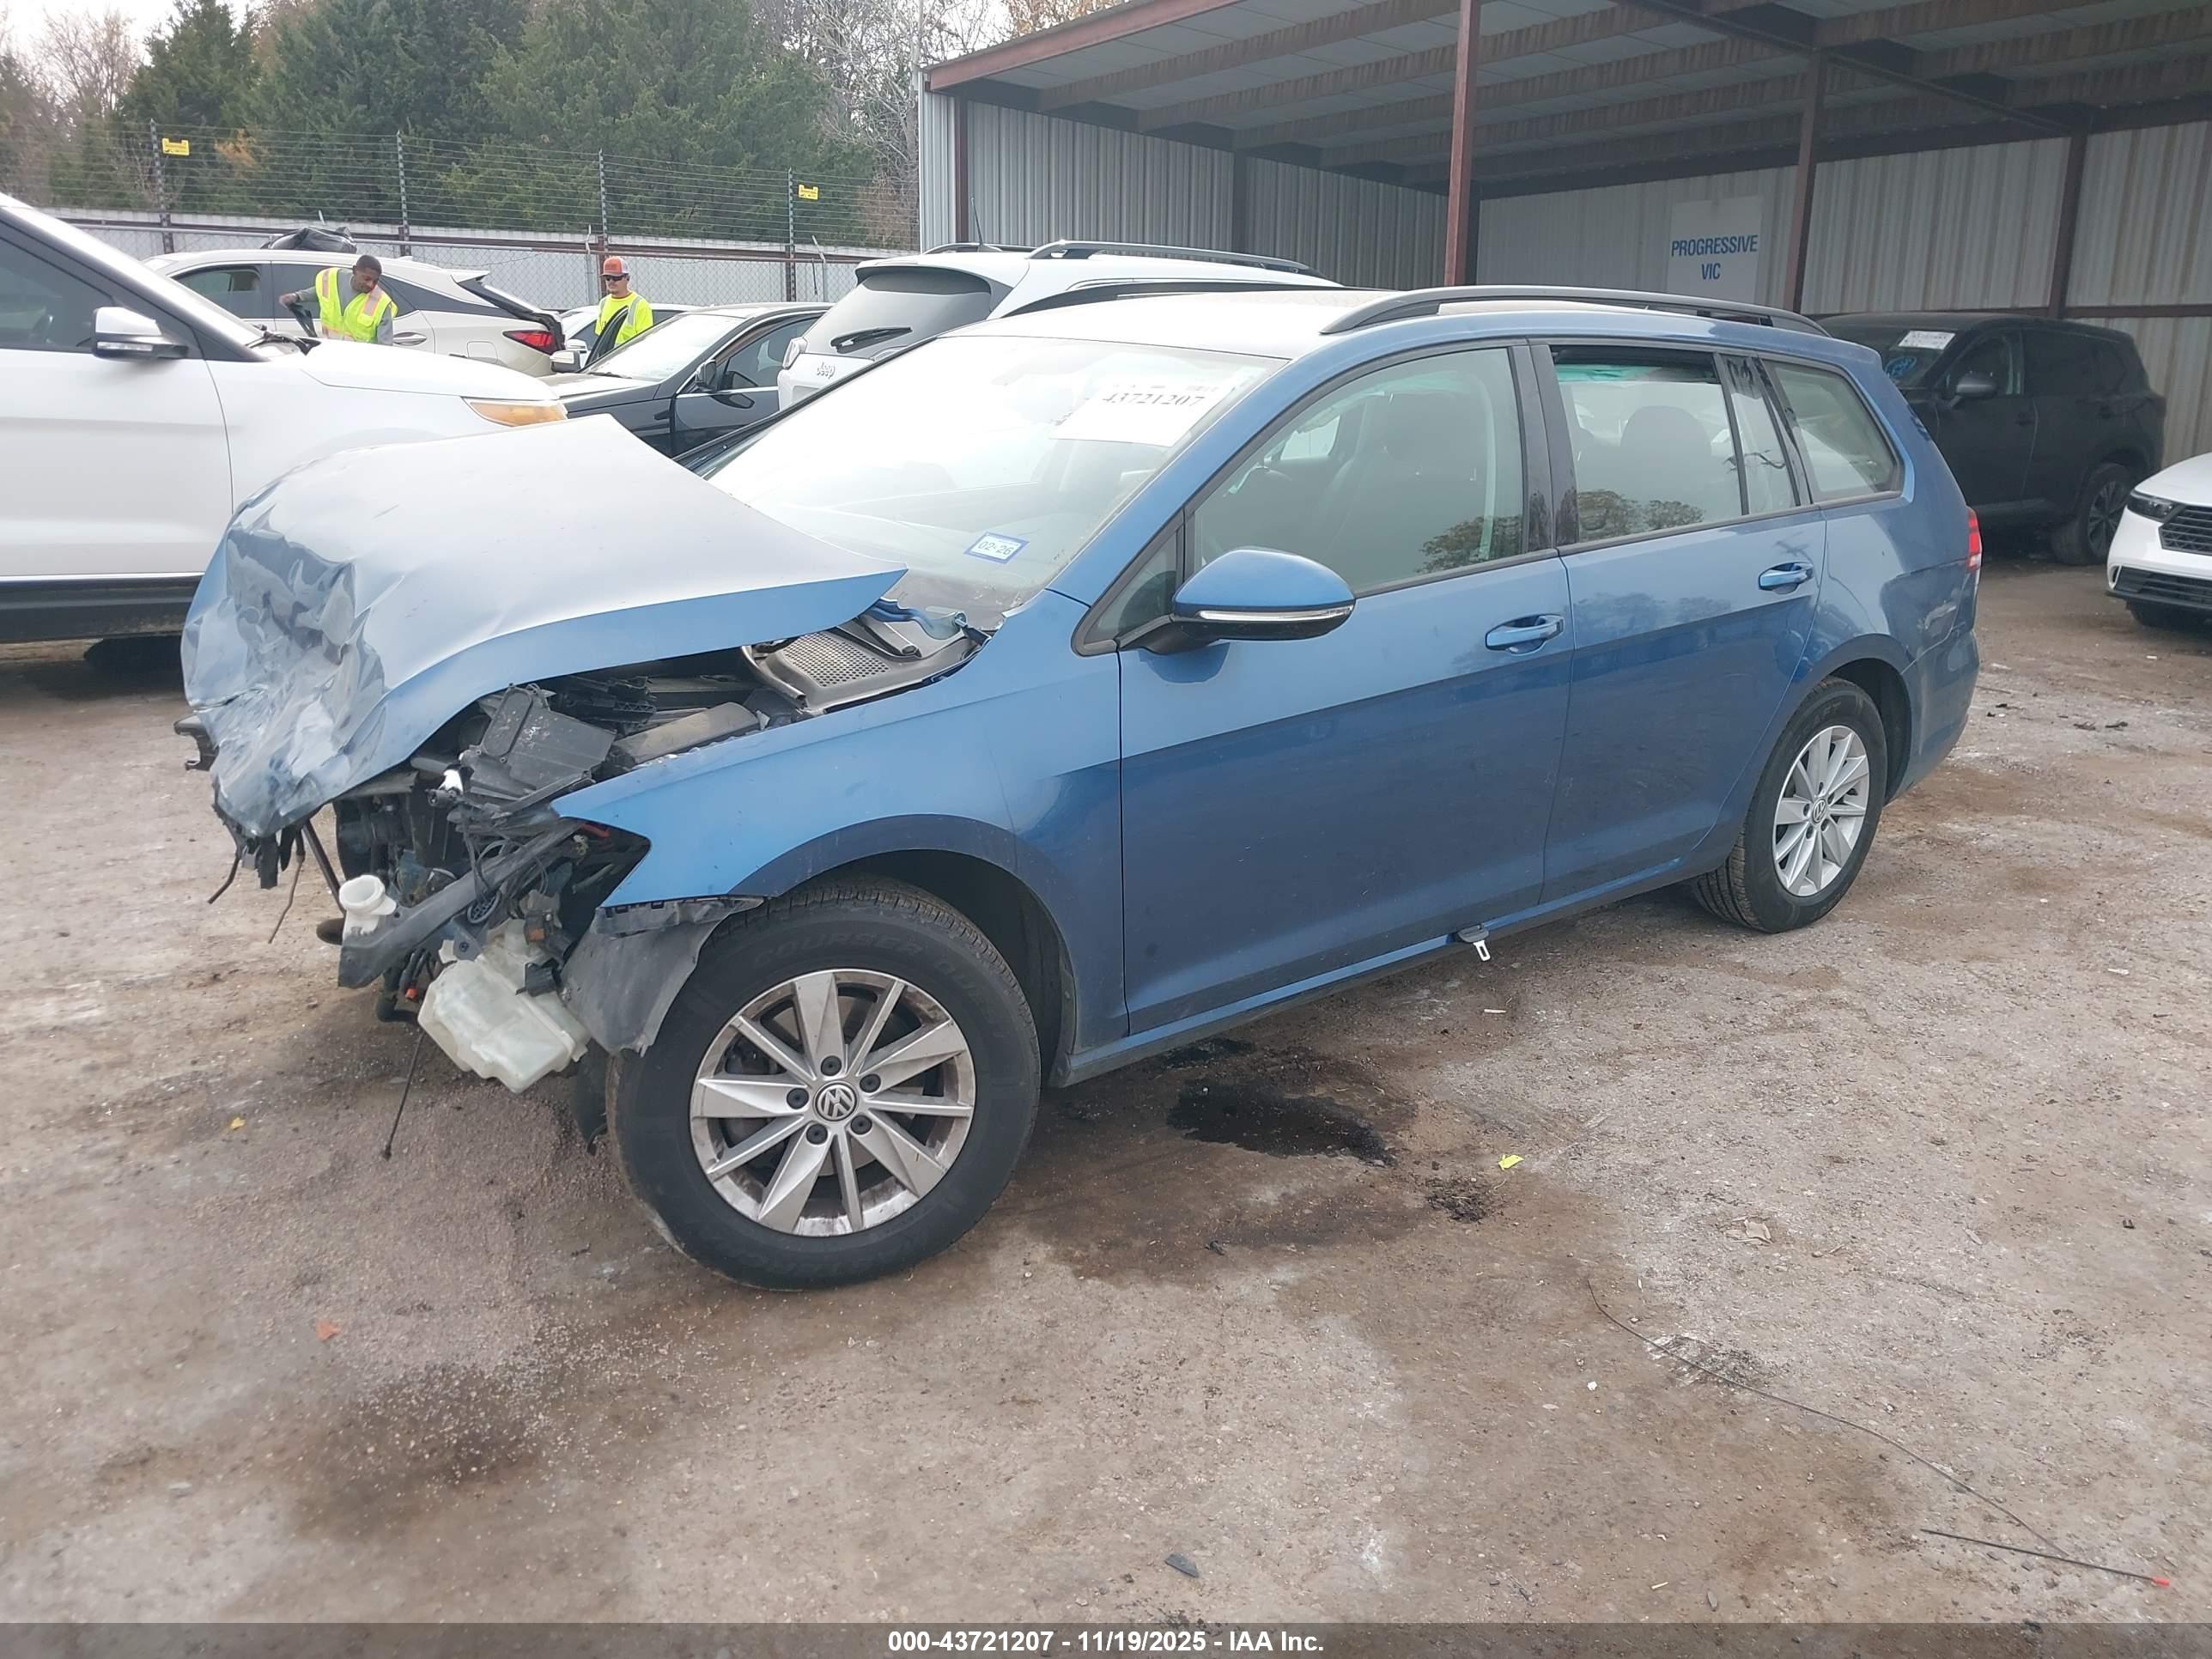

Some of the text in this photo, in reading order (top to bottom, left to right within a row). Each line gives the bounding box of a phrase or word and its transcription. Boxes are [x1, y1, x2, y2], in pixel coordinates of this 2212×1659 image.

[1671, 234, 1759, 257] PROGRESSIVE
[1701, 263, 1721, 280] VIC
[817, 362, 836, 380] Jeep
[1102, 392, 1206, 406] 43721207
